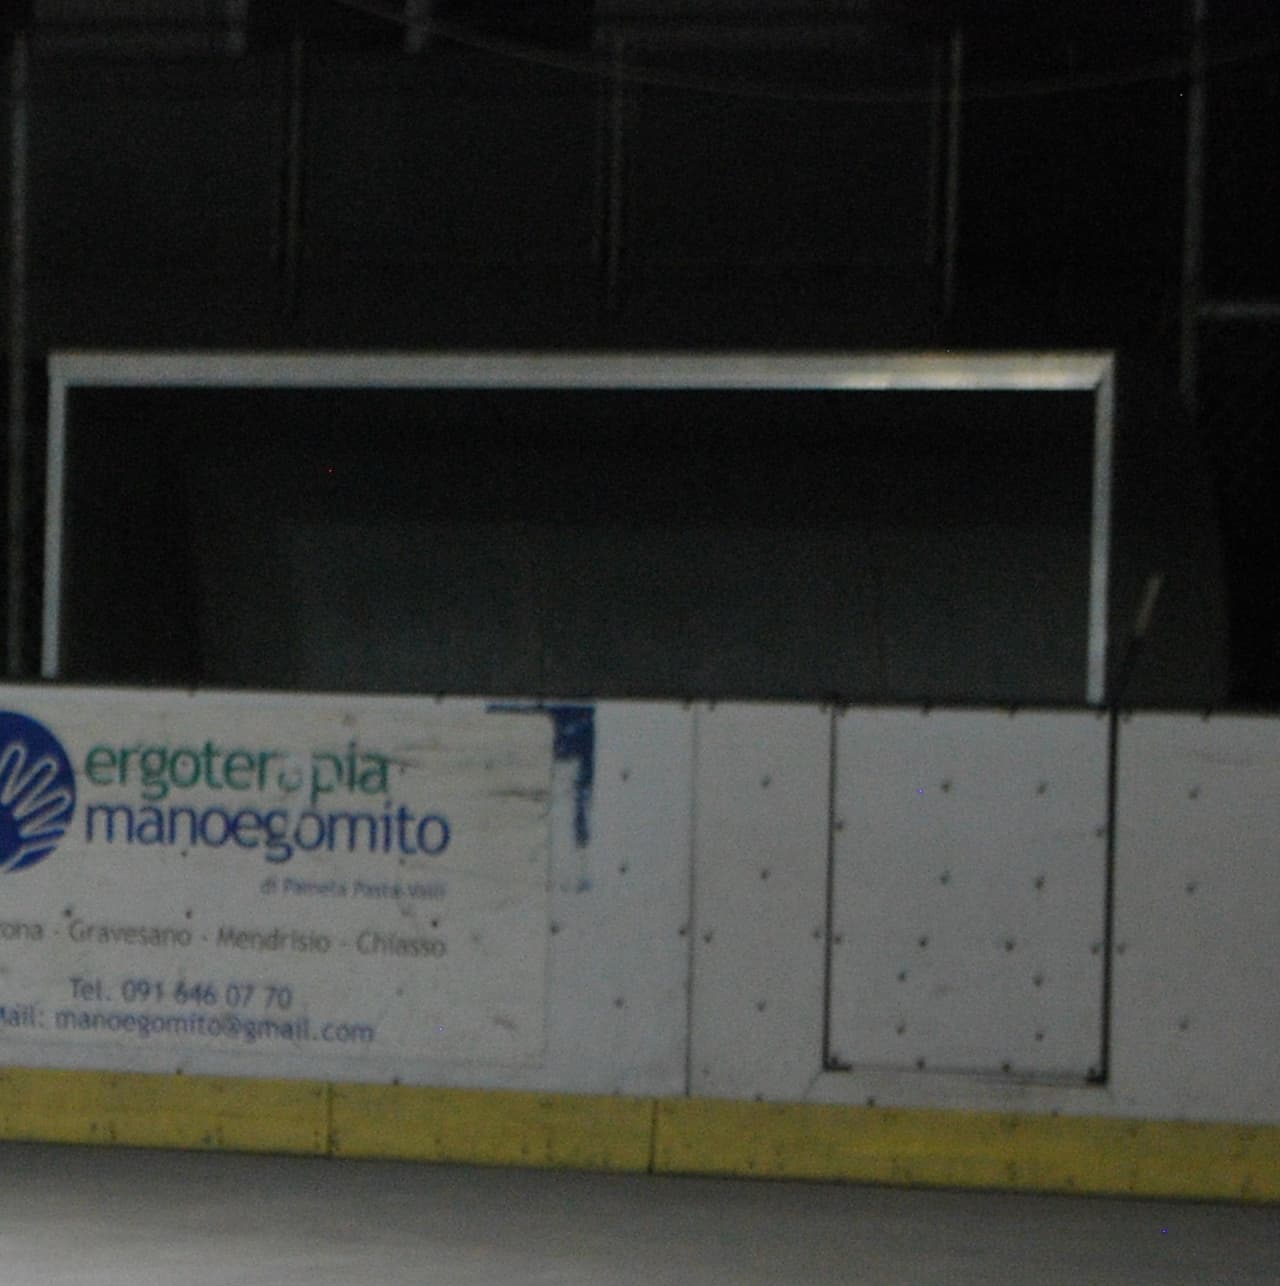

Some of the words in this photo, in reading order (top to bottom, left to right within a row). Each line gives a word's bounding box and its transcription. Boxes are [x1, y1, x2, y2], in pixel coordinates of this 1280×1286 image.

[84, 800, 452, 864] manoegomito
[68, 918, 192, 949] Gravesano
[217, 924, 332, 954] Mendrisio
[356, 930, 448, 960] Chiasso
[69, 975, 111, 1002] Tel.
[121, 978, 164, 1004] 091
[171, 979, 219, 1006] 646
[225, 982, 256, 1007] 07
[262, 983, 294, 1010] 70
[52, 1009, 377, 1044] manoegomito@gmail.com
